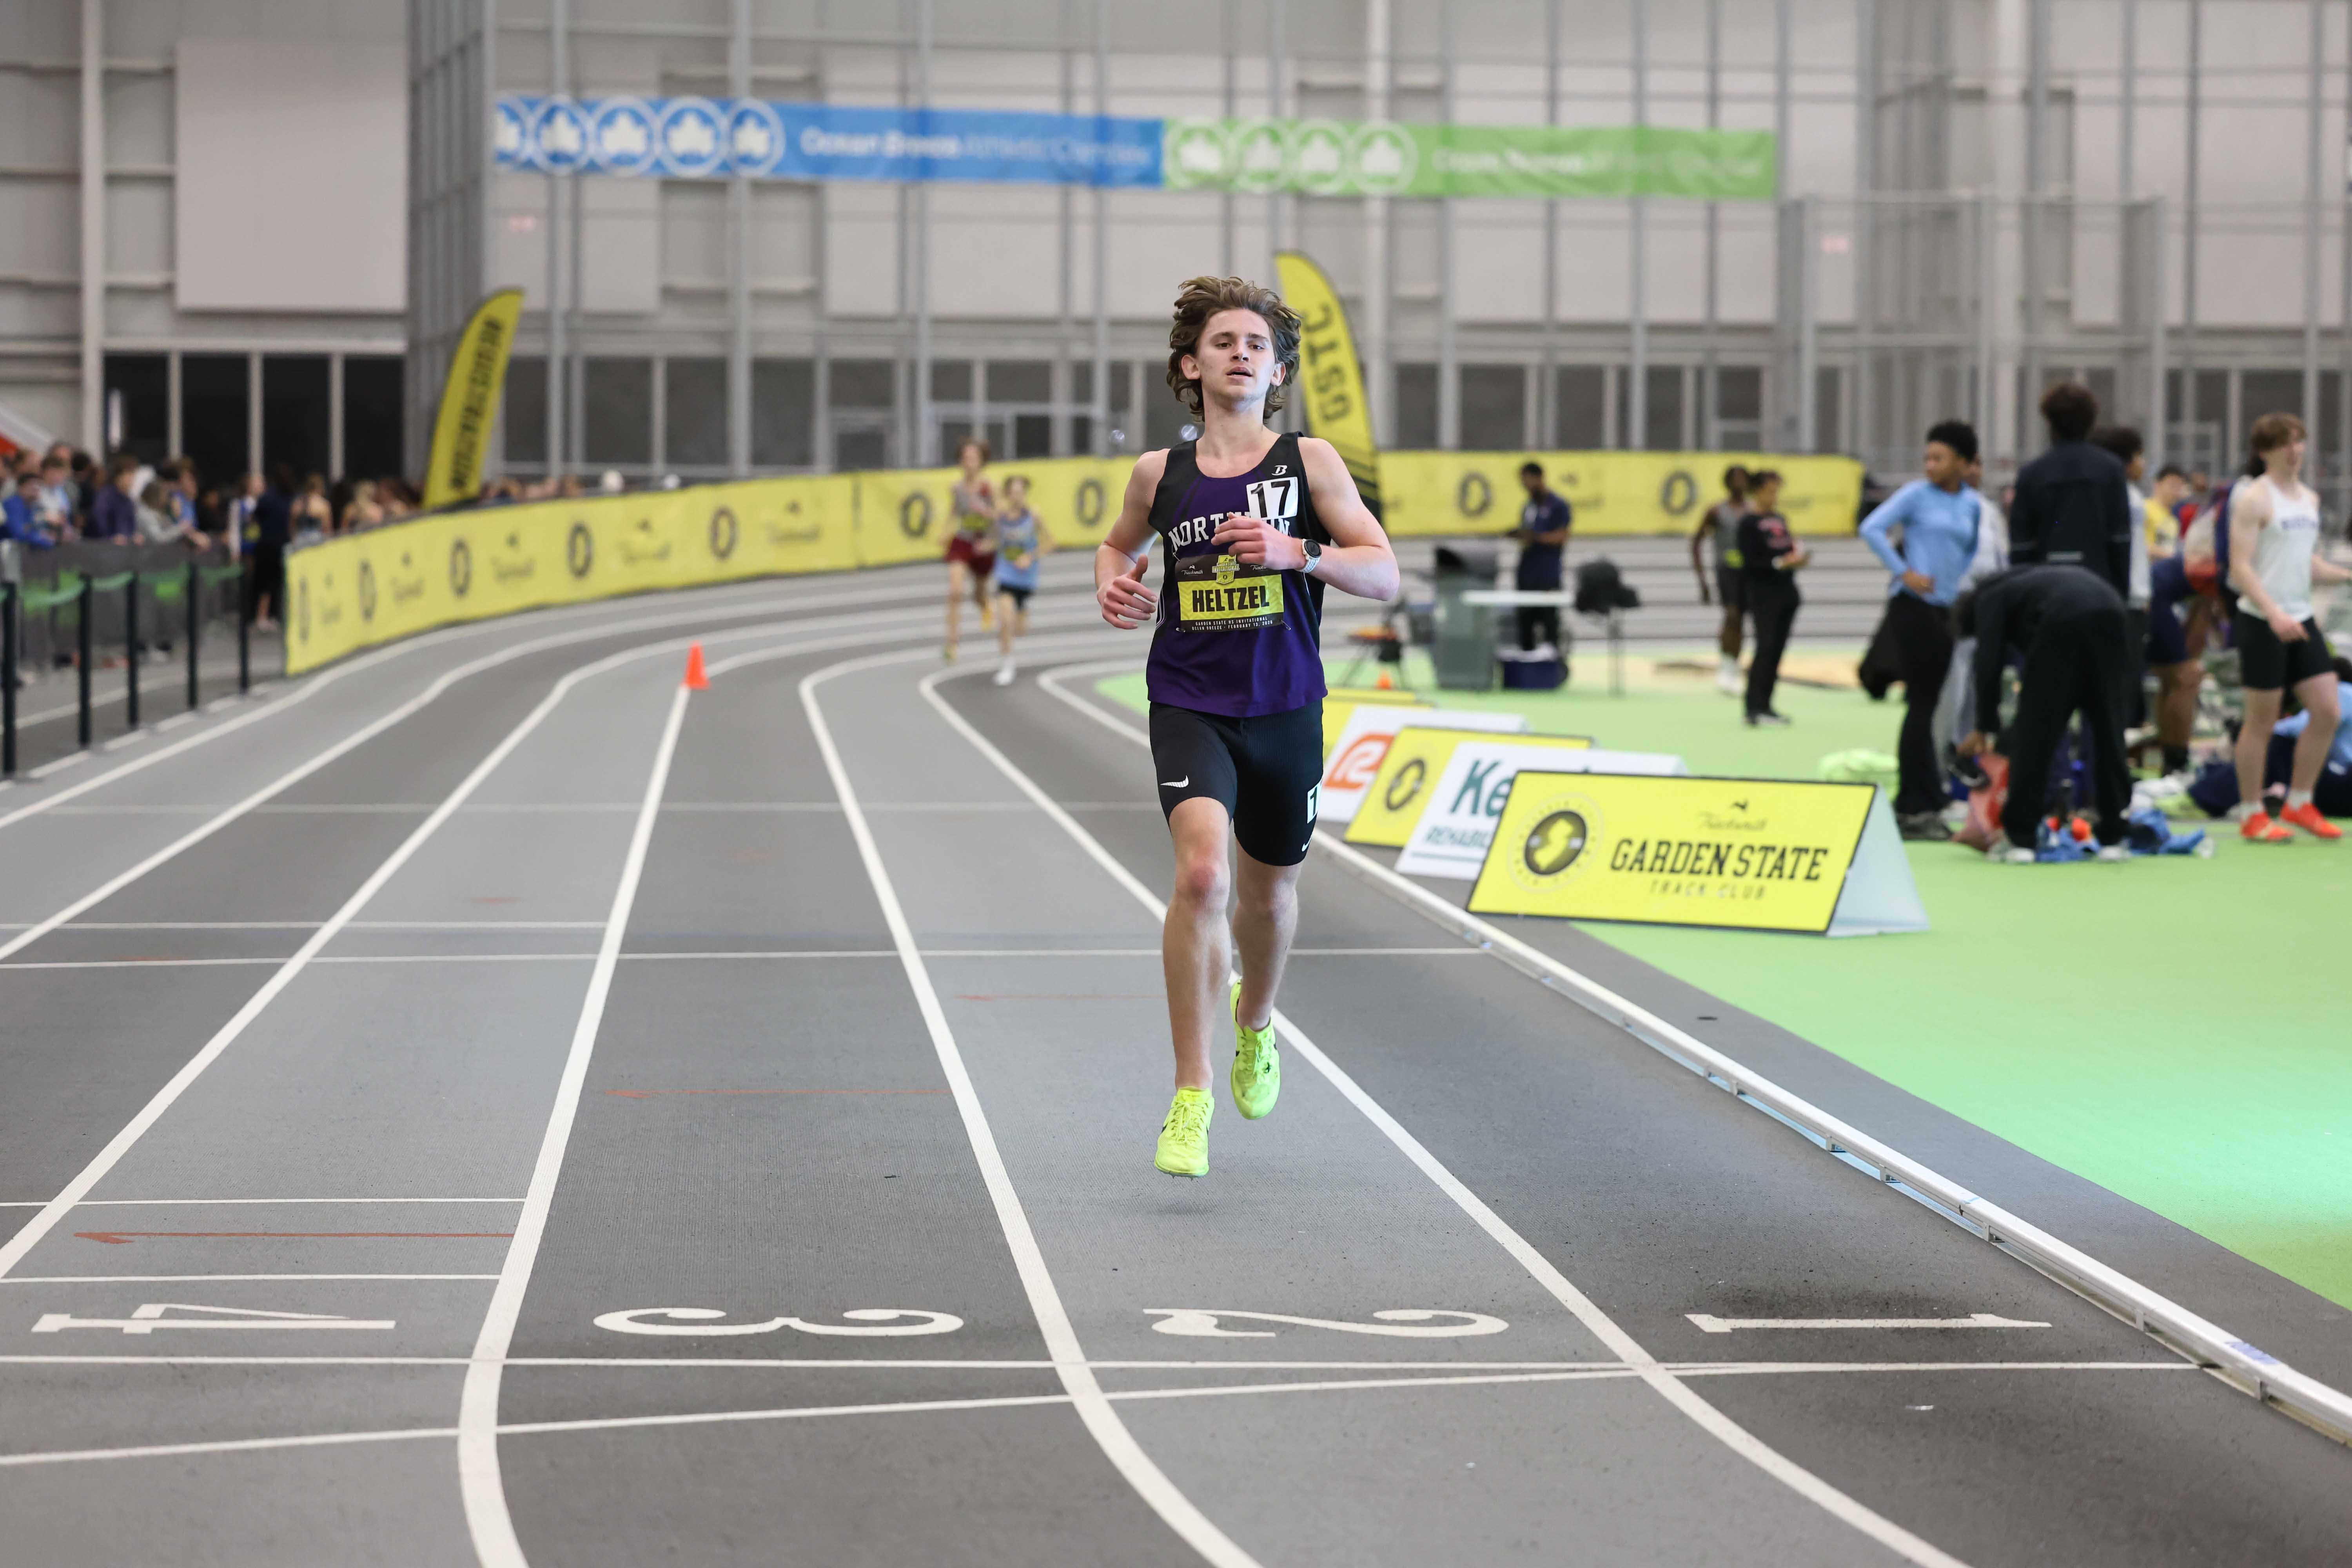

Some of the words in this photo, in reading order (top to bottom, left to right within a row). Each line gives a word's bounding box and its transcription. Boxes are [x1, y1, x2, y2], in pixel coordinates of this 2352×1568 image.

[1251, 480, 1290, 518] 17
[1192, 585, 1269, 612] HELTZEL
[1610, 838, 1733, 877] GARDEN
[1733, 844, 1828, 881] STATE
[1649, 879, 1706, 898] TRACK
[1717, 883, 1766, 901] CLUB
[593, 1308, 964, 1336] 3
[1142, 1308, 1509, 1338] 2
[1684, 1313, 2053, 1332] 1
